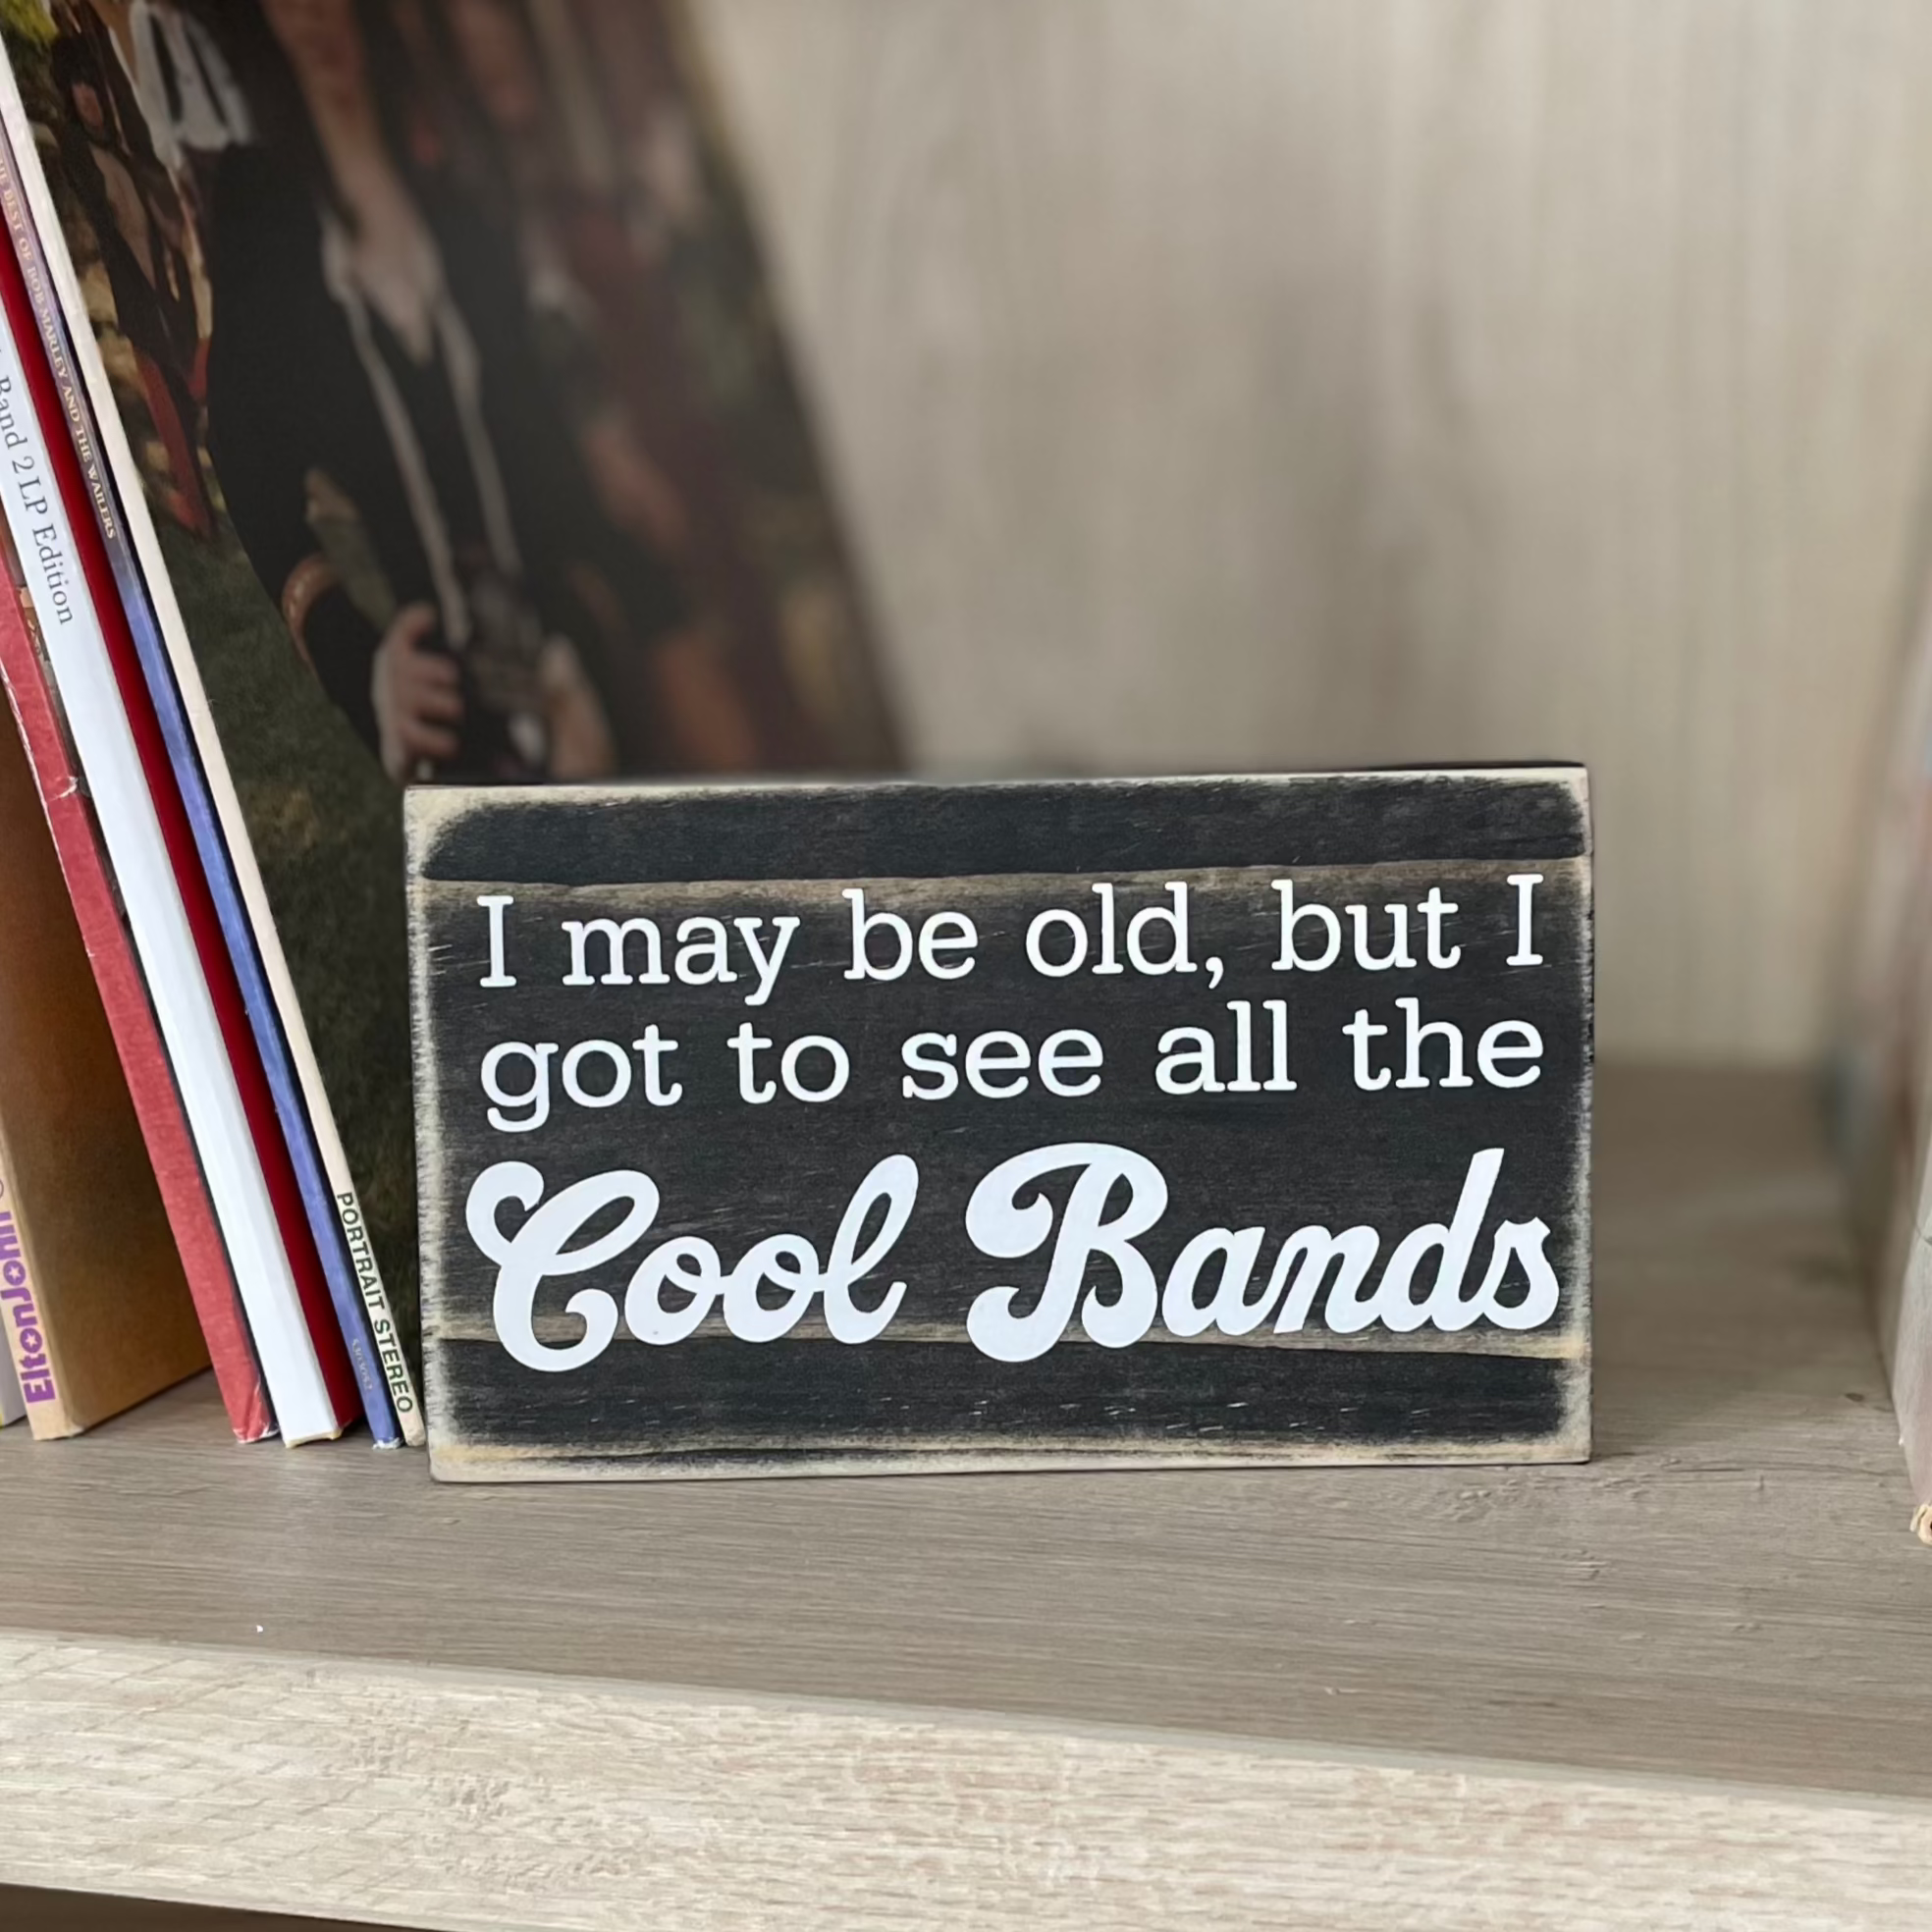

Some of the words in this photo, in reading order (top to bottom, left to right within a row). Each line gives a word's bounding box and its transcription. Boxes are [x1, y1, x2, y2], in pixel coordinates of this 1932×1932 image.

[4, 189, 23, 231] BEST
[19, 238, 32, 261] OF
[27, 266, 44, 305] BOB
[39, 307, 69, 380] MARLEY
[62, 385, 80, 422] AND
[76, 425, 92, 462] THE
[87, 463, 116, 539] WAILERS
[32, 523, 74, 625] Edition
[477, 896, 515, 988] I
[562, 917, 800, 1005] may
[842, 887, 978, 980] be
[1027, 882, 1224, 989] old,
[1271, 879, 1461, 972] but
[1507, 874, 1544, 966] I
[481, 1024, 682, 1132] got
[727, 1022, 849, 1106] to
[901, 1029, 1103, 1100] see
[1155, 999, 1298, 1095] all
[1342, 997, 1543, 1091] the
[337, 1192, 385, 1311] PORTRAIT
[373, 1317, 413, 1413] STEREO
[466, 1154, 919, 1372] Cool
[966, 1143, 1560, 1363] Bands
